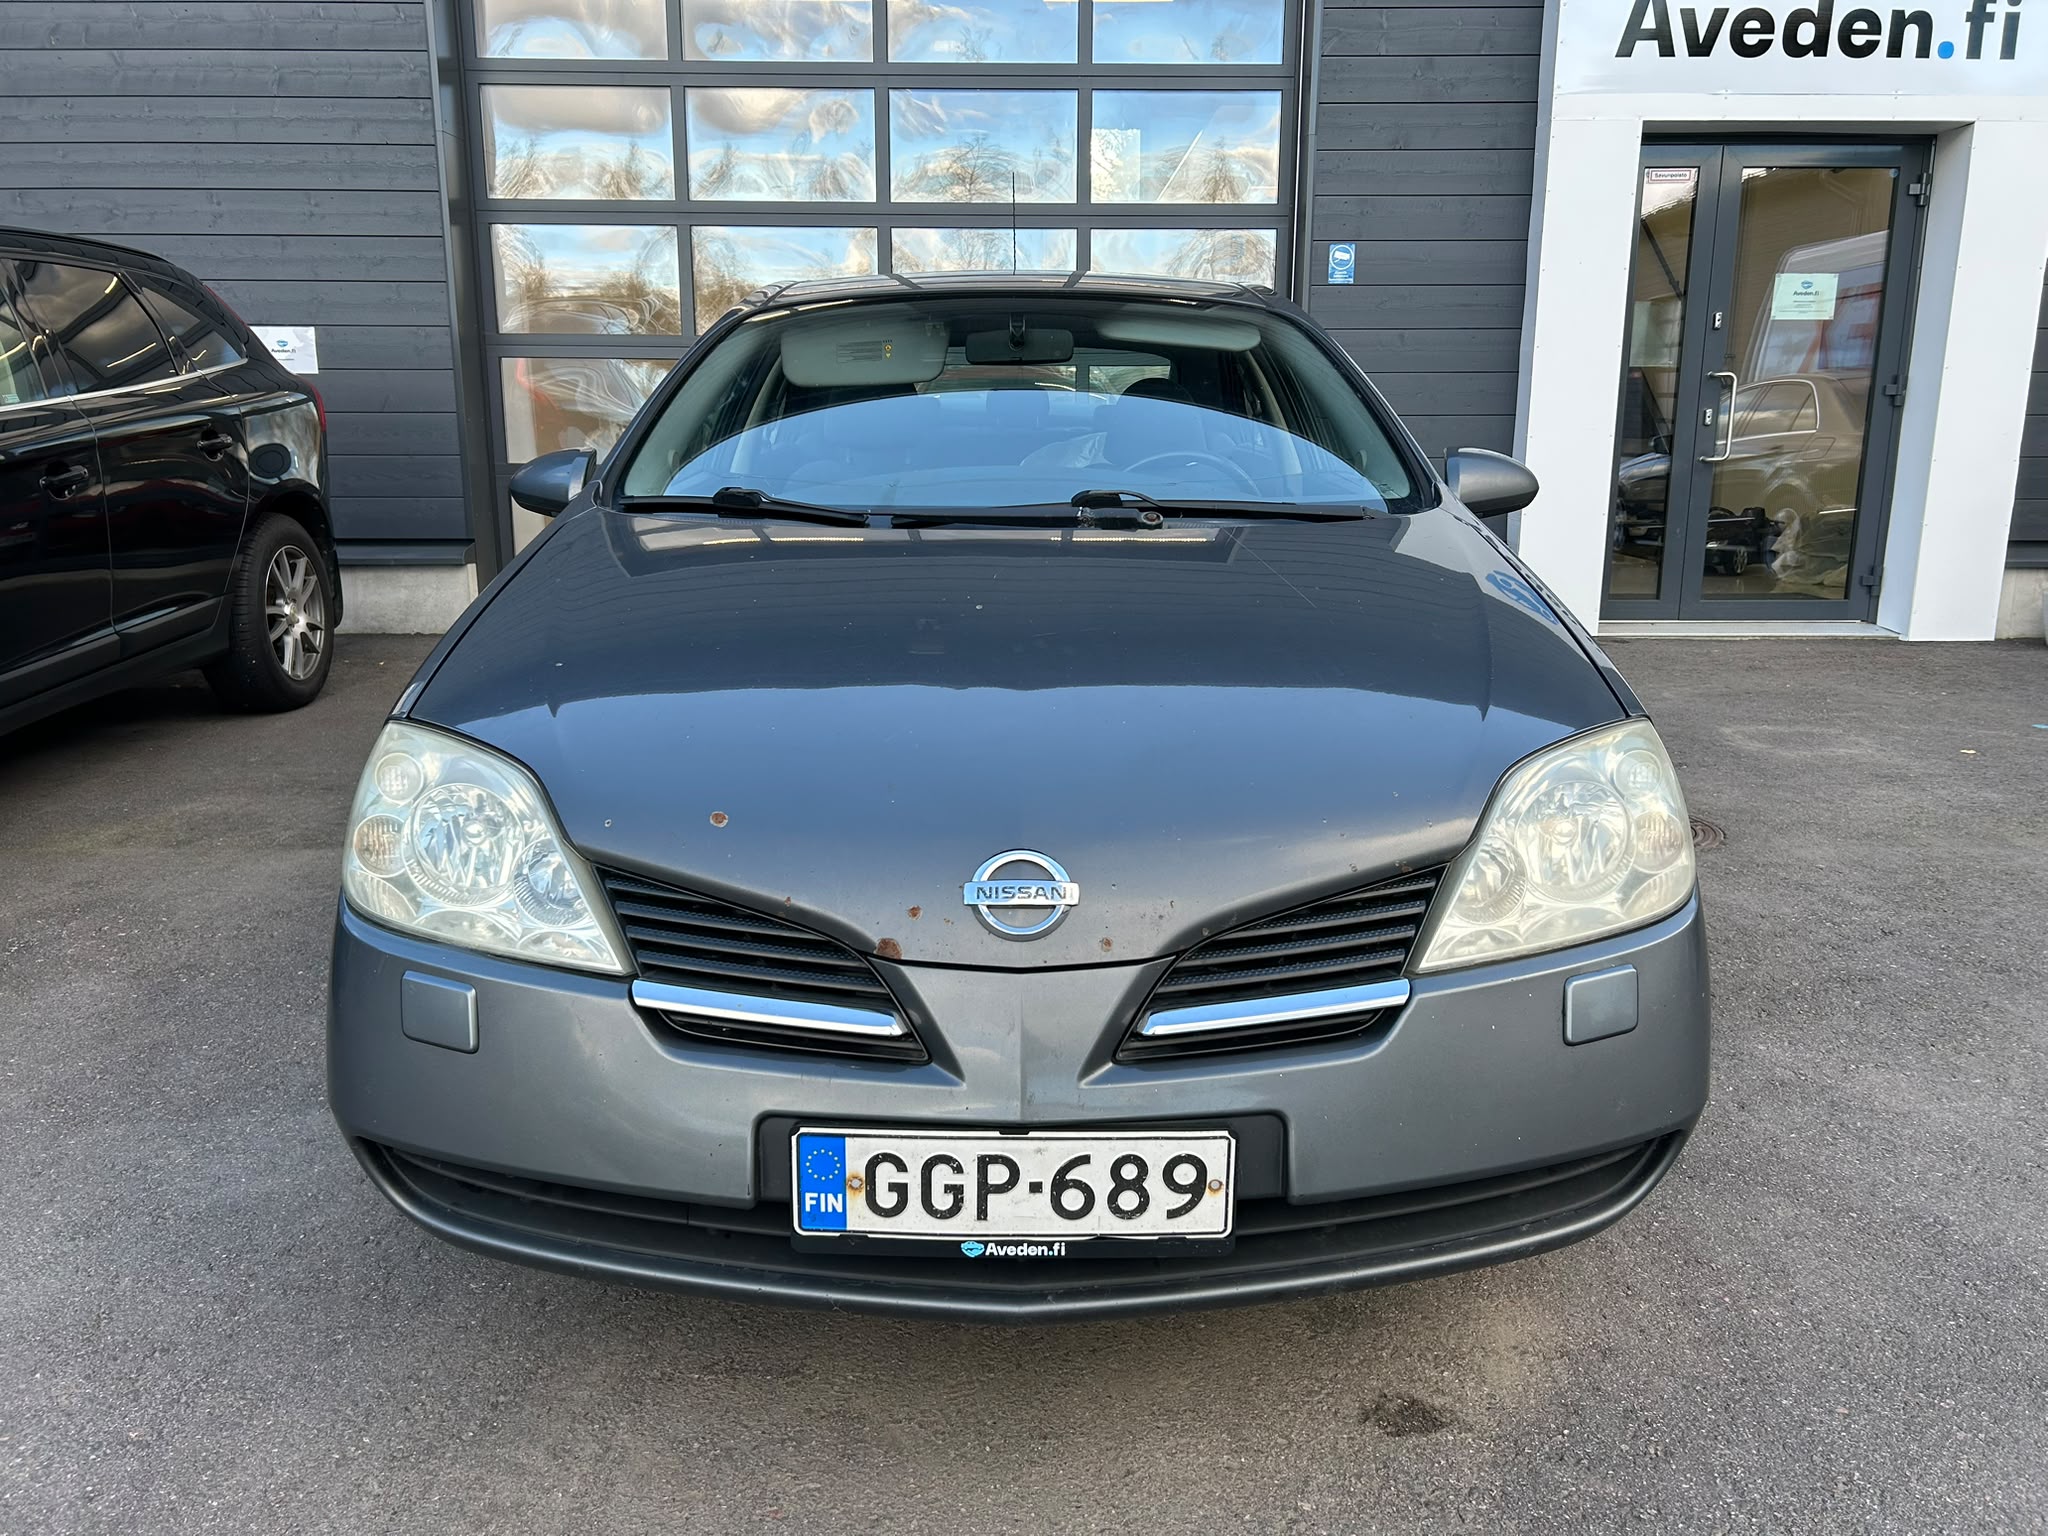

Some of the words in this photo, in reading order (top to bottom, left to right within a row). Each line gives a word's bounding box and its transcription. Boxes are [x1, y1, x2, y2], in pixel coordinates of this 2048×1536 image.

[1615, 0, 2021, 59] Aveden.fi
[976, 886, 1066, 900] NISSAN
[864, 1151, 1208, 1221] GGP-689
[804, 1192, 844, 1214] FIN
[985, 1241, 1065, 1256] Aveden.fi
